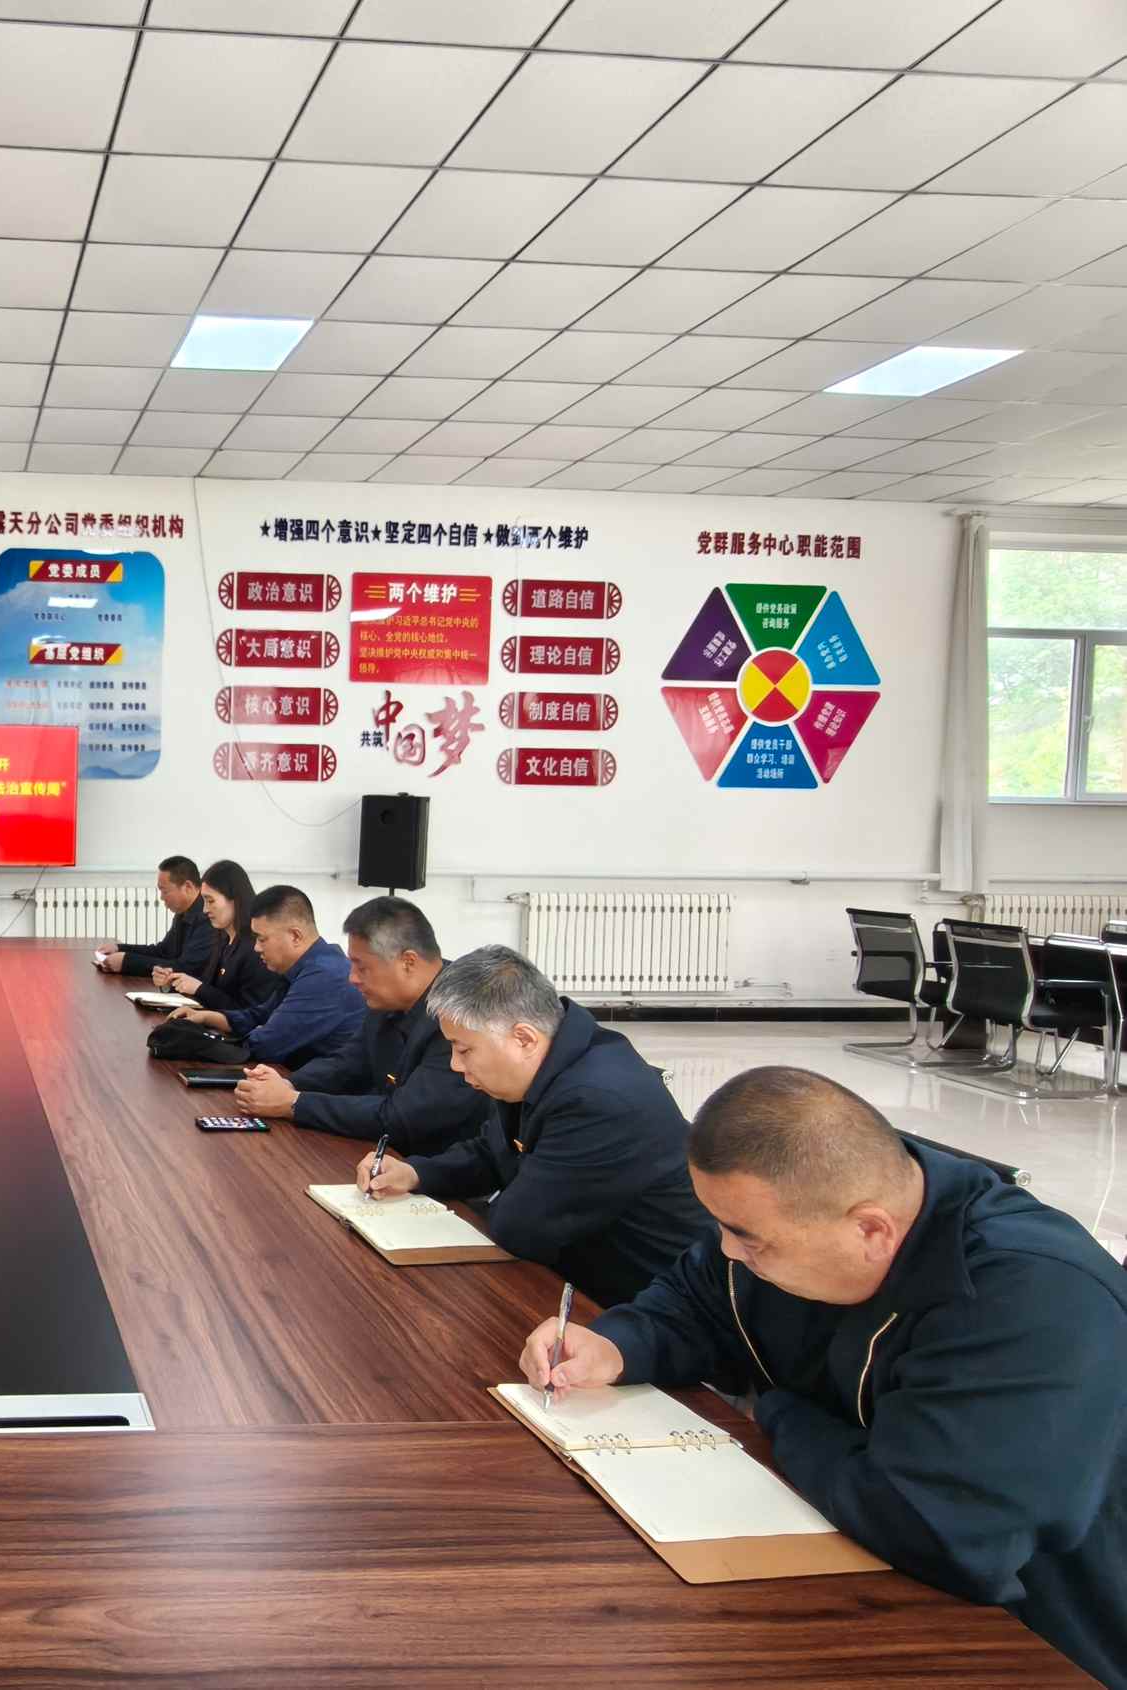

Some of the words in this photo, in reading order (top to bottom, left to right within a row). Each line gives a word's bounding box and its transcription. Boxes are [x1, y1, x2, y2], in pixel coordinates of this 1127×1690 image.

[697, 530, 862, 559] 党群服务中心职能范围
[48, 562, 101, 578] 党委成员
[247, 582, 314, 604] 政治意识
[388, 582, 458, 604] 两个维护
[531, 588, 595, 610] 道路自信
[246, 636, 312, 659] 大局意识
[530, 646, 594, 667] 理论自信
[245, 694, 311, 716] 核心意识
[529, 701, 592, 722] 制度自信
[360, 729, 384, 748] 共筑
[526, 756, 588, 778] 文化自信
